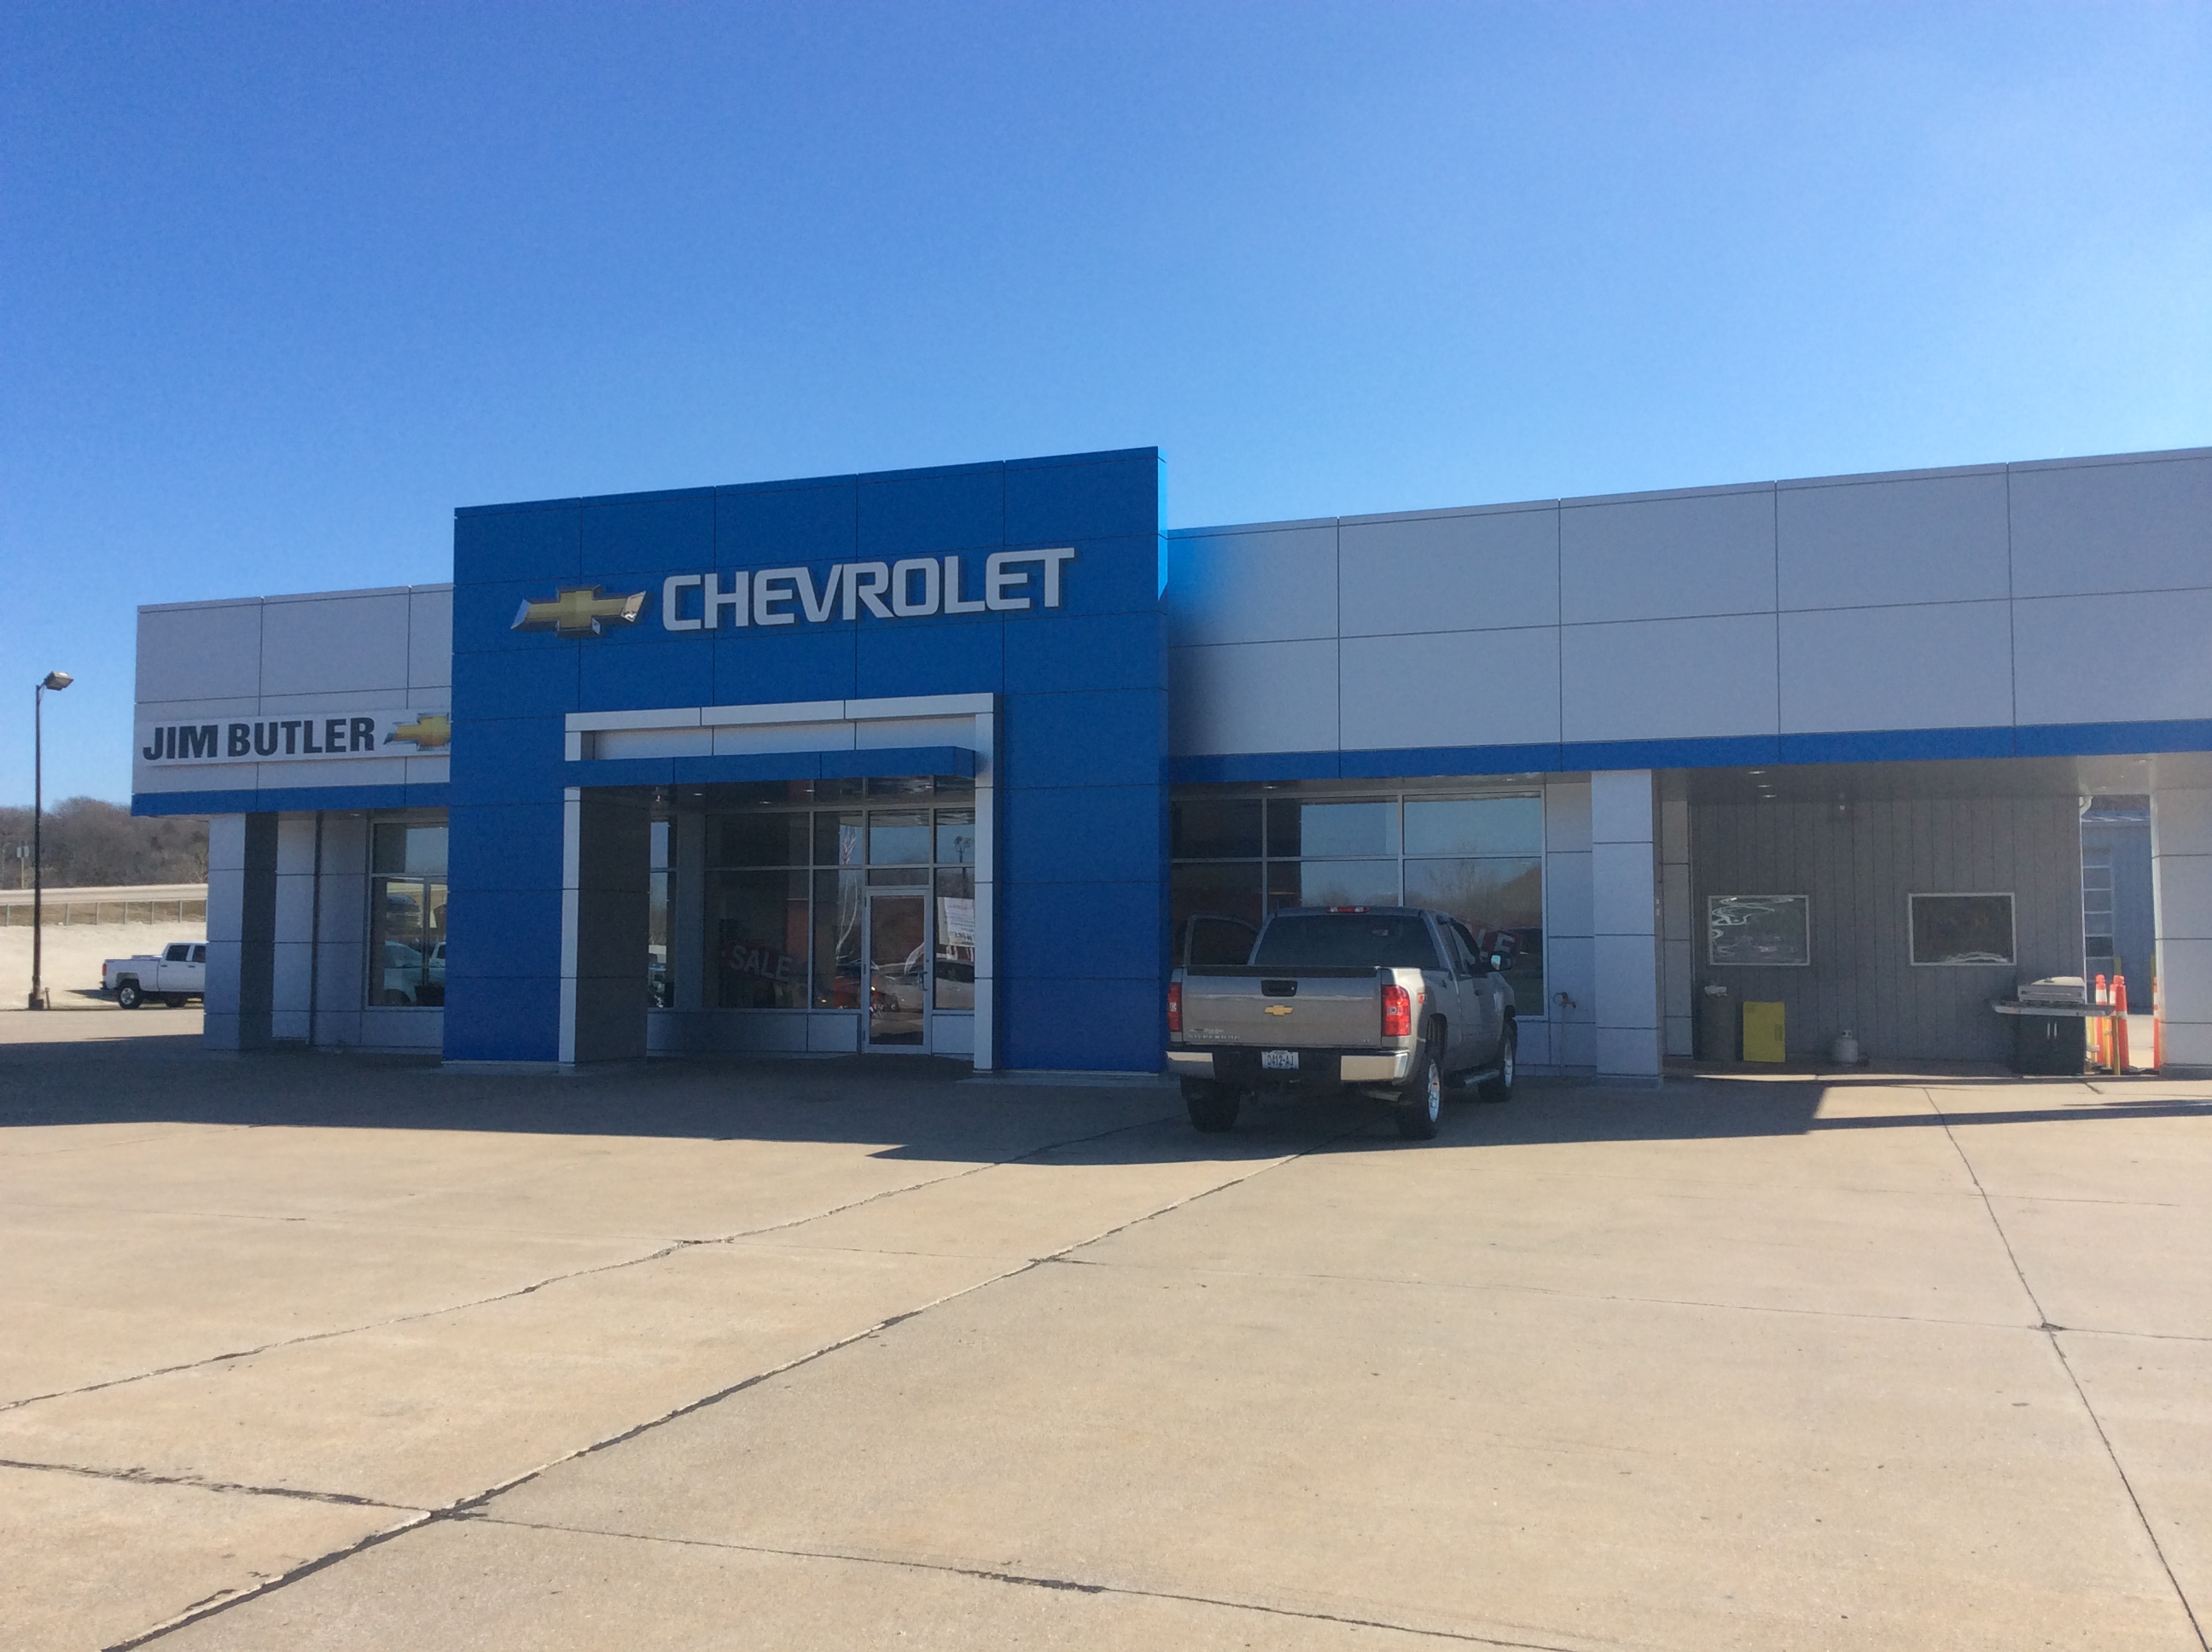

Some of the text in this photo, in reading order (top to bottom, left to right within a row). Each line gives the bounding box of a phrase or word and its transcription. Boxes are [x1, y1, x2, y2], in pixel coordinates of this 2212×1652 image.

[663, 547, 1074, 631] CHEVROLET
[143, 717, 375, 760] JIM BUTLER
[730, 945, 793, 982] SALE
